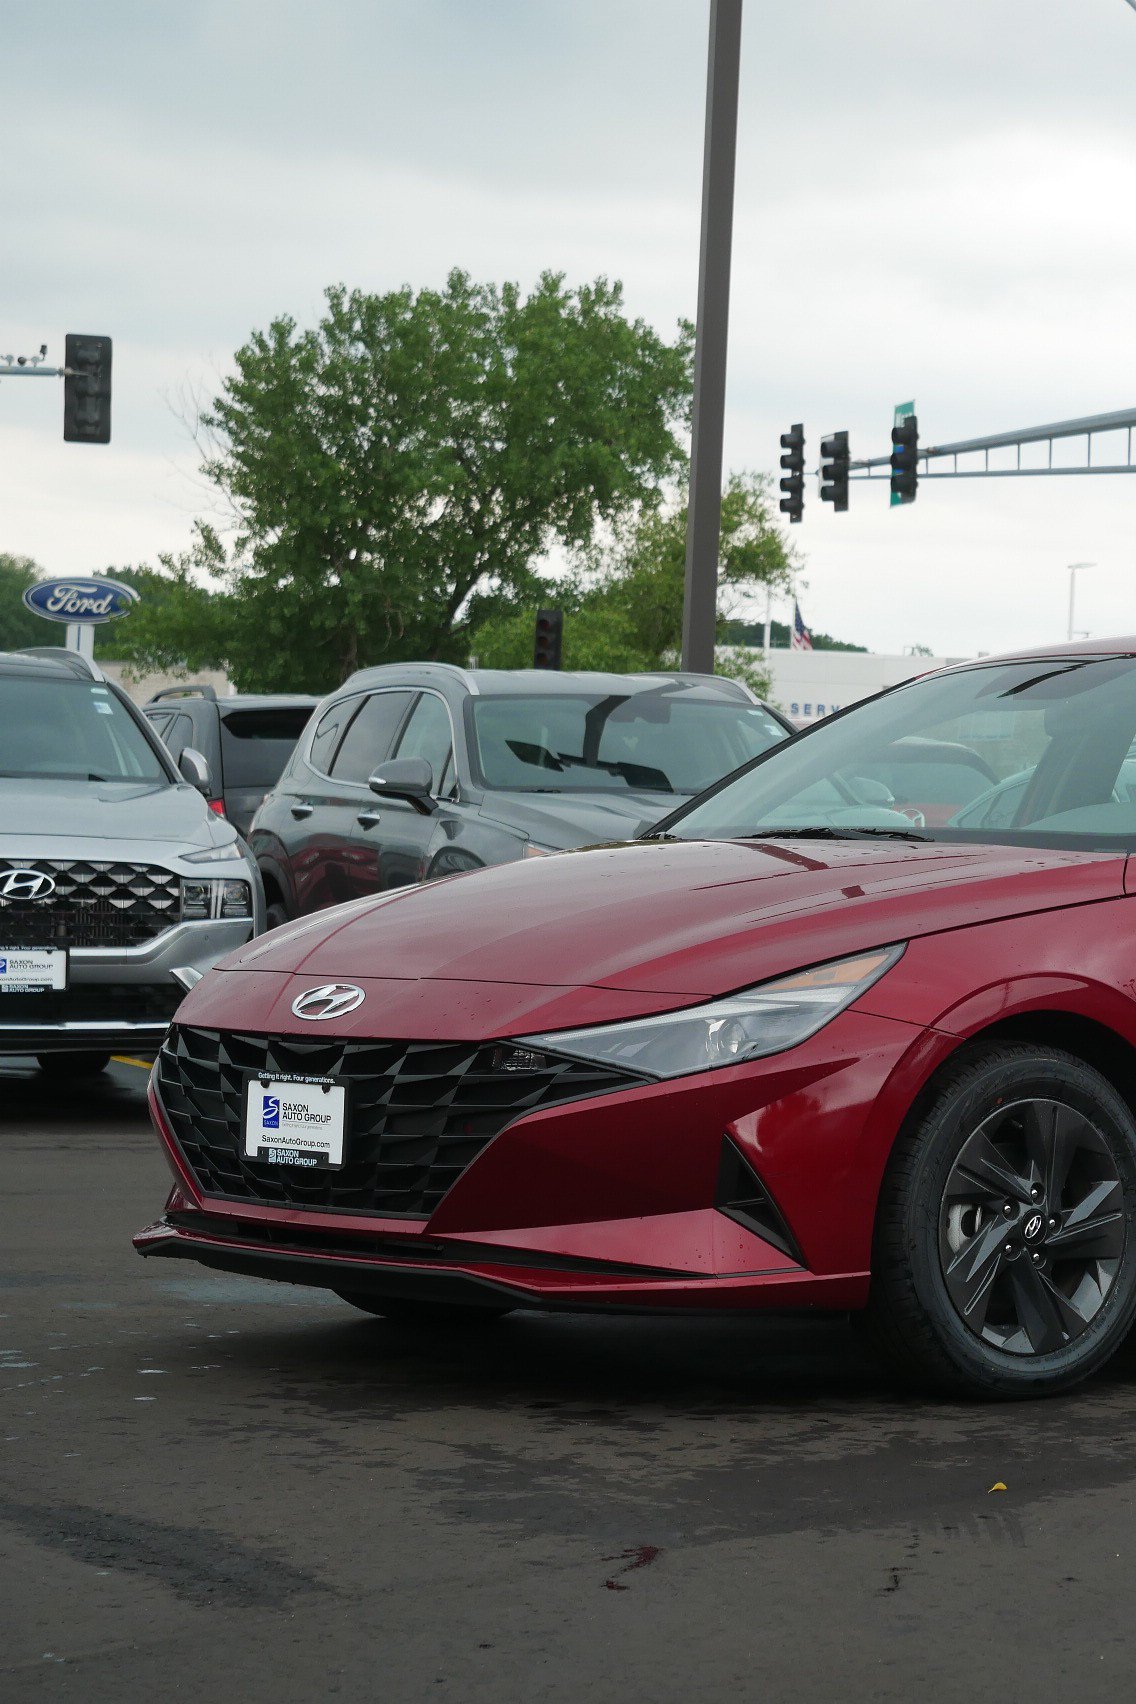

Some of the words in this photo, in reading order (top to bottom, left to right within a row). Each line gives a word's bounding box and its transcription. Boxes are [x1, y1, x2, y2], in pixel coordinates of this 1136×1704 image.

[46, 584, 114, 614] Ford
[282, 1102, 309, 1112] SAXON
[282, 1112, 303, 1121] AUTO
[304, 1114, 332, 1123] GROUP
[262, 1135, 330, 1148] SaxonAutoGroup.com
[277, 1149, 299, 1157] SAXON
[276, 1156, 294, 1164] AUTO
[294, 1157, 318, 1167] GROUP
